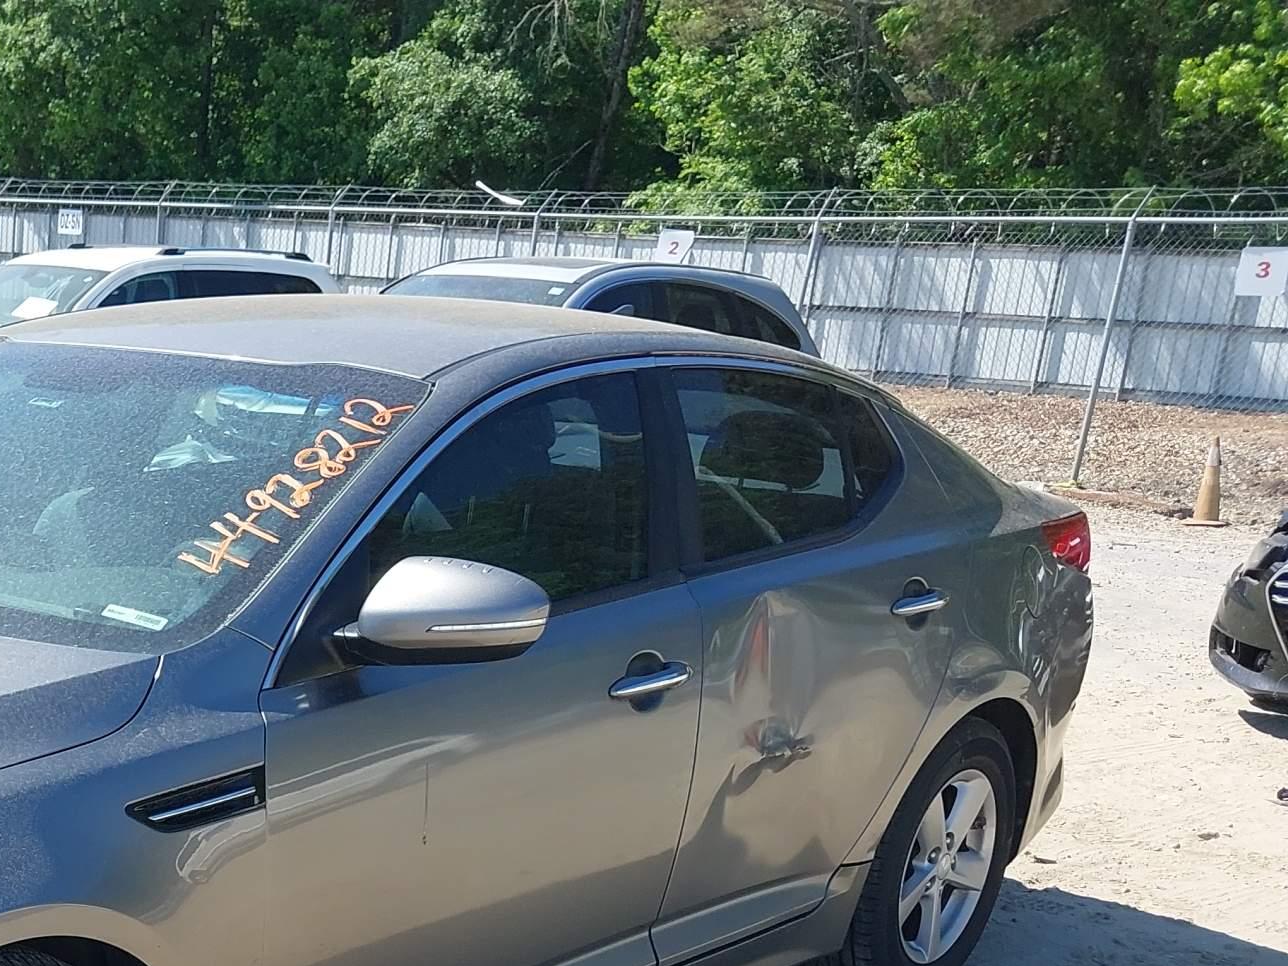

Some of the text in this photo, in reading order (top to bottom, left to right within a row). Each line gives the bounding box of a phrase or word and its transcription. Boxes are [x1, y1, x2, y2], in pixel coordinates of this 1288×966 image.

[667, 241, 679, 255] 2
[1255, 261, 1271, 278] 3
[177, 398, 415, 574] 44928212
